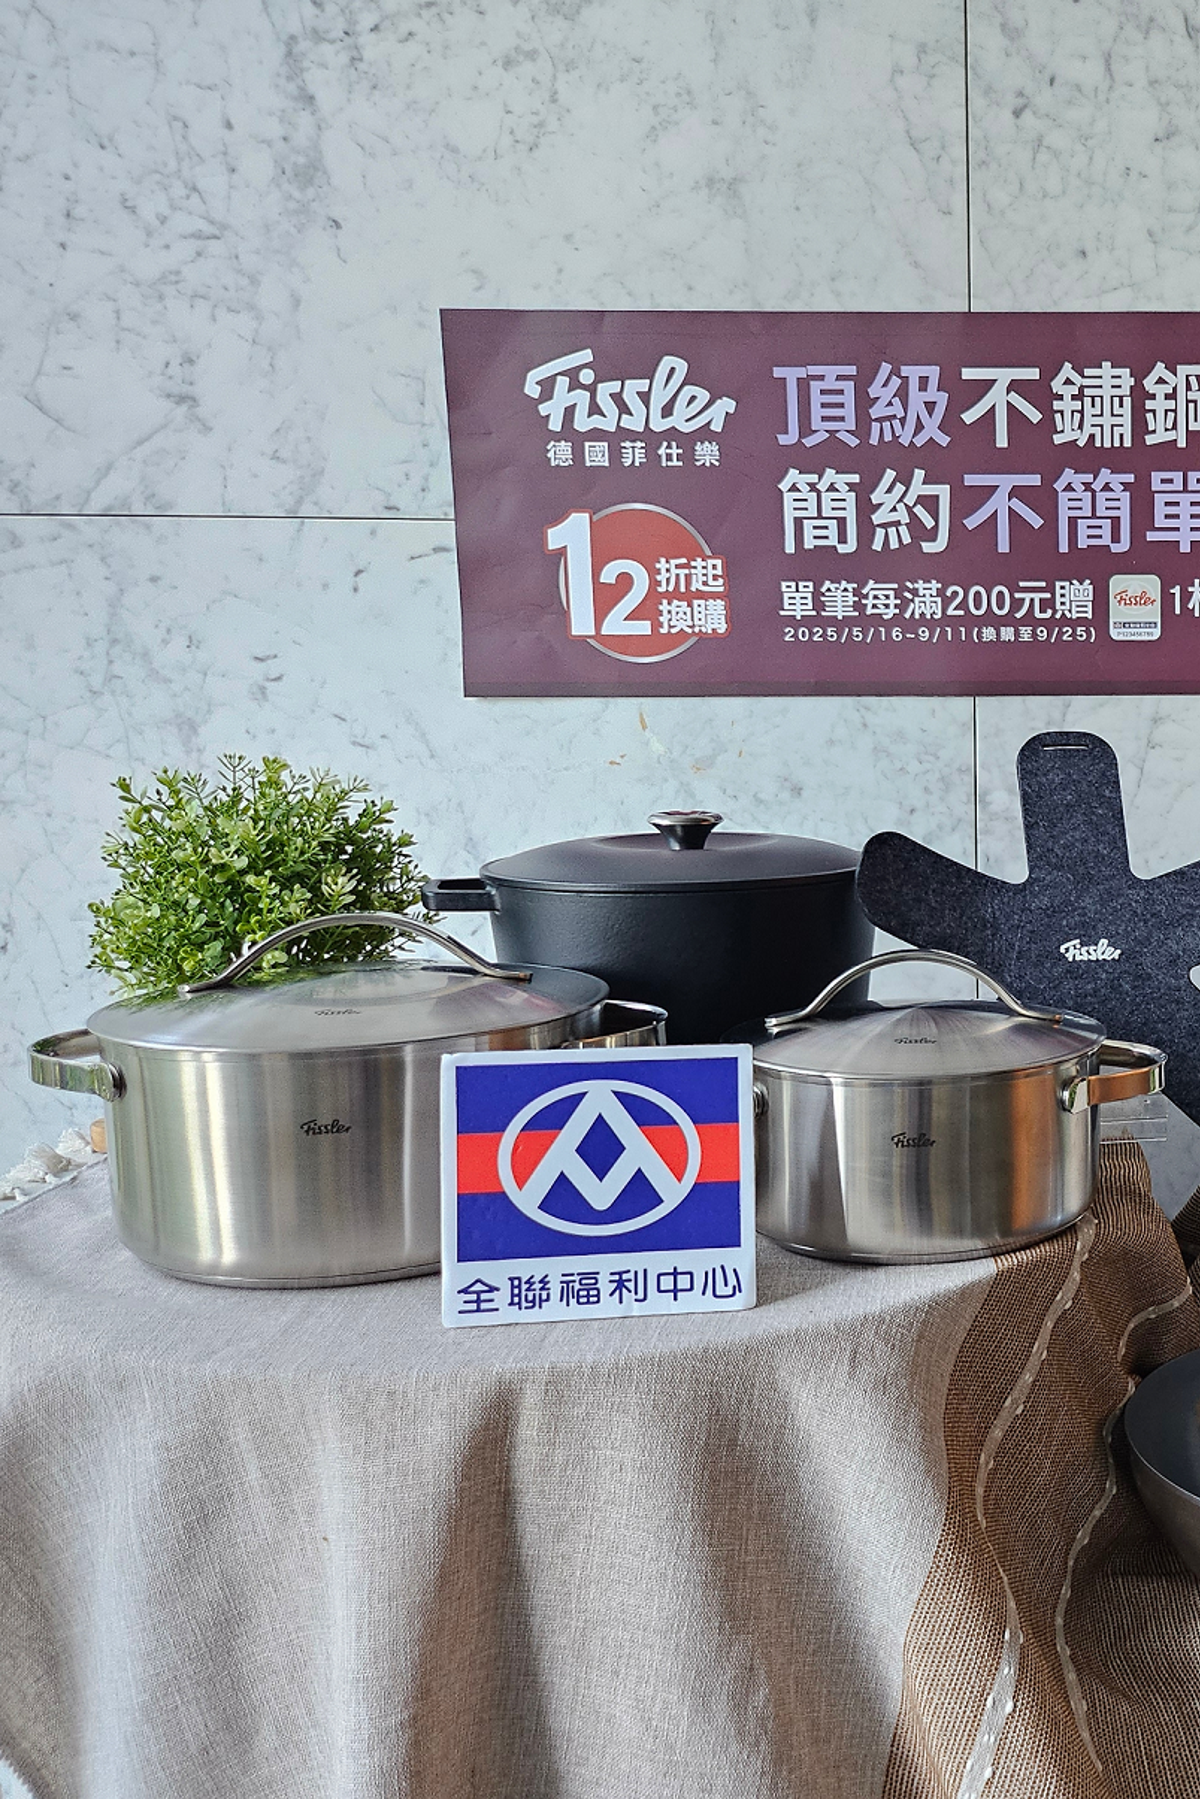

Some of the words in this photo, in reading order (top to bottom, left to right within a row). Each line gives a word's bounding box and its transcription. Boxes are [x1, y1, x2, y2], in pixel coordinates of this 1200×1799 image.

[523, 348, 737, 434] Fissler
[546, 440, 721, 467] 德國菲仕樂
[778, 578, 1094, 621] 單筆每滿200元贈
[1113, 588, 1157, 607] Fissler
[658, 599, 728, 634] 換購
[1060, 938, 1122, 962] Fissler
[300, 1118, 352, 1137] Fissler
[891, 1131, 936, 1149] Fissler
[456, 1263, 743, 1315] 全聯福利中心
